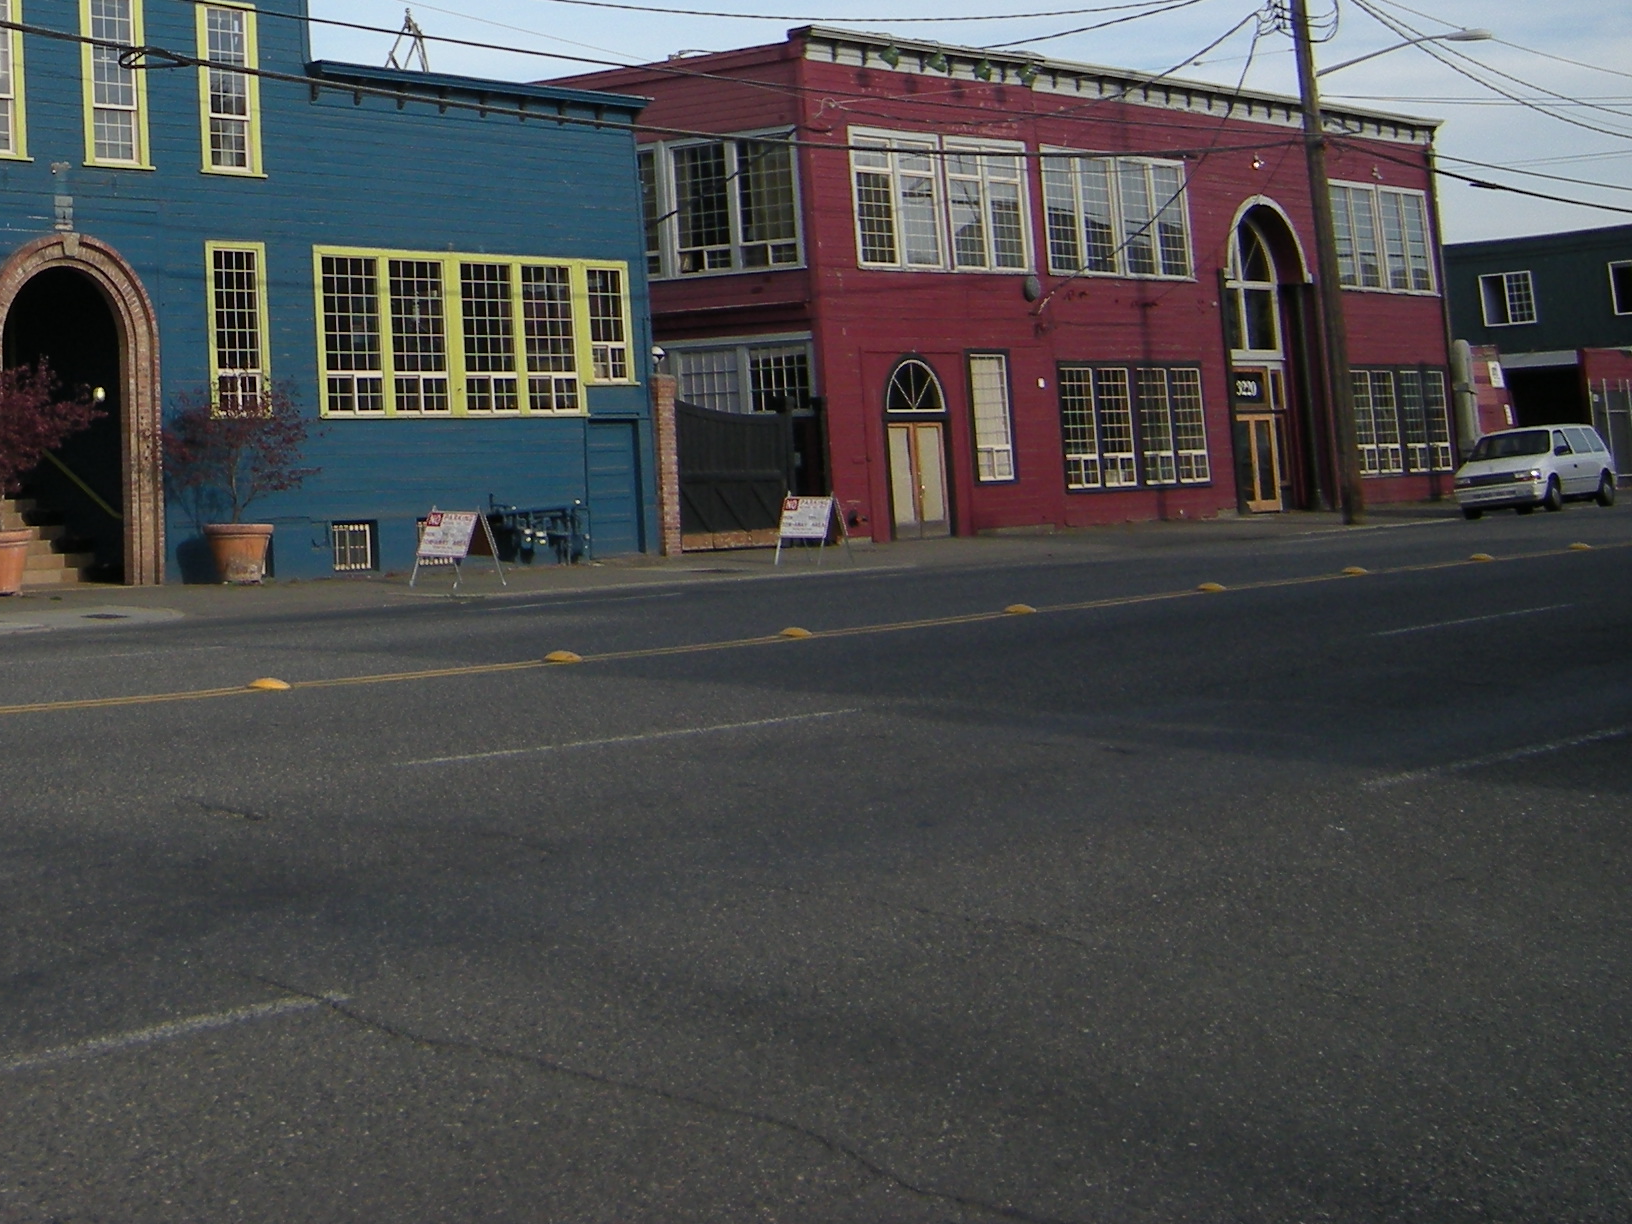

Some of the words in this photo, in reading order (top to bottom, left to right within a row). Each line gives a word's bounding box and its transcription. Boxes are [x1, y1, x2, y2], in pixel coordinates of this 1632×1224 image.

[1236, 380, 1257, 396] 3220
[785, 499, 798, 509] NO
[429, 514, 442, 525] NO
